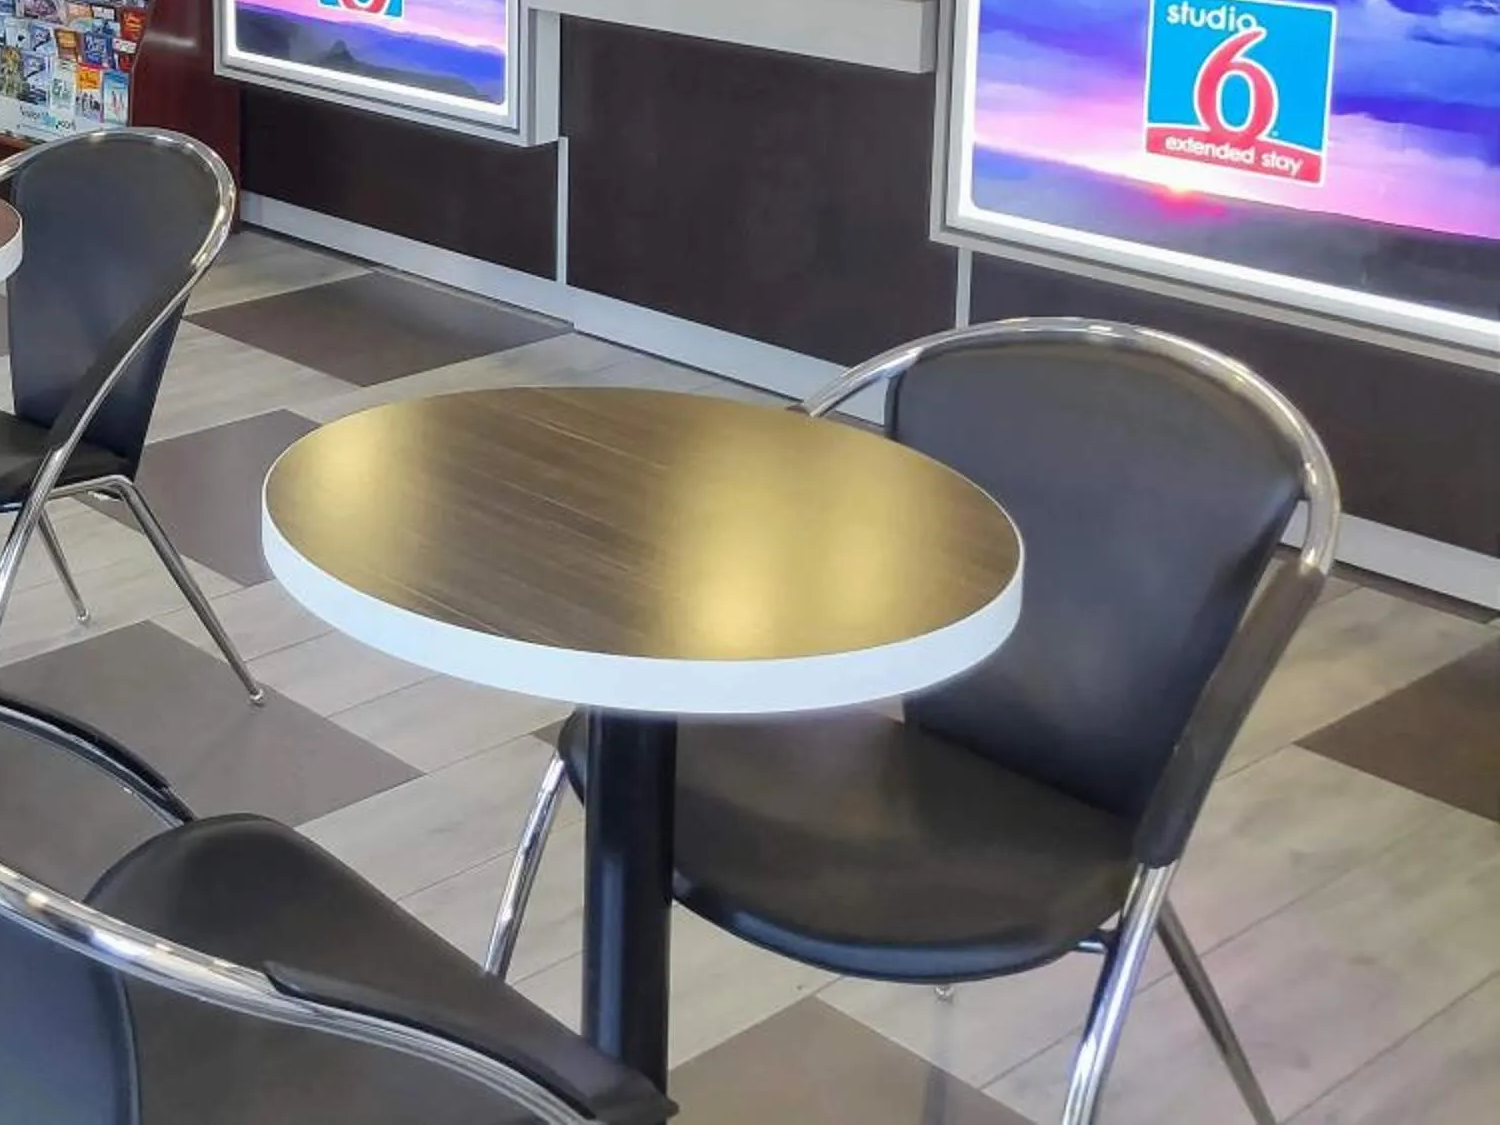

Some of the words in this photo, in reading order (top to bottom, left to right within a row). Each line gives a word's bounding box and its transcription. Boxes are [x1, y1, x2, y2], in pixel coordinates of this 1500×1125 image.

[1166, 1, 1258, 32] studio
[1193, 27, 1279, 141] 6
[1165, 135, 1256, 164] extended
[1261, 151, 1304, 177] stay
